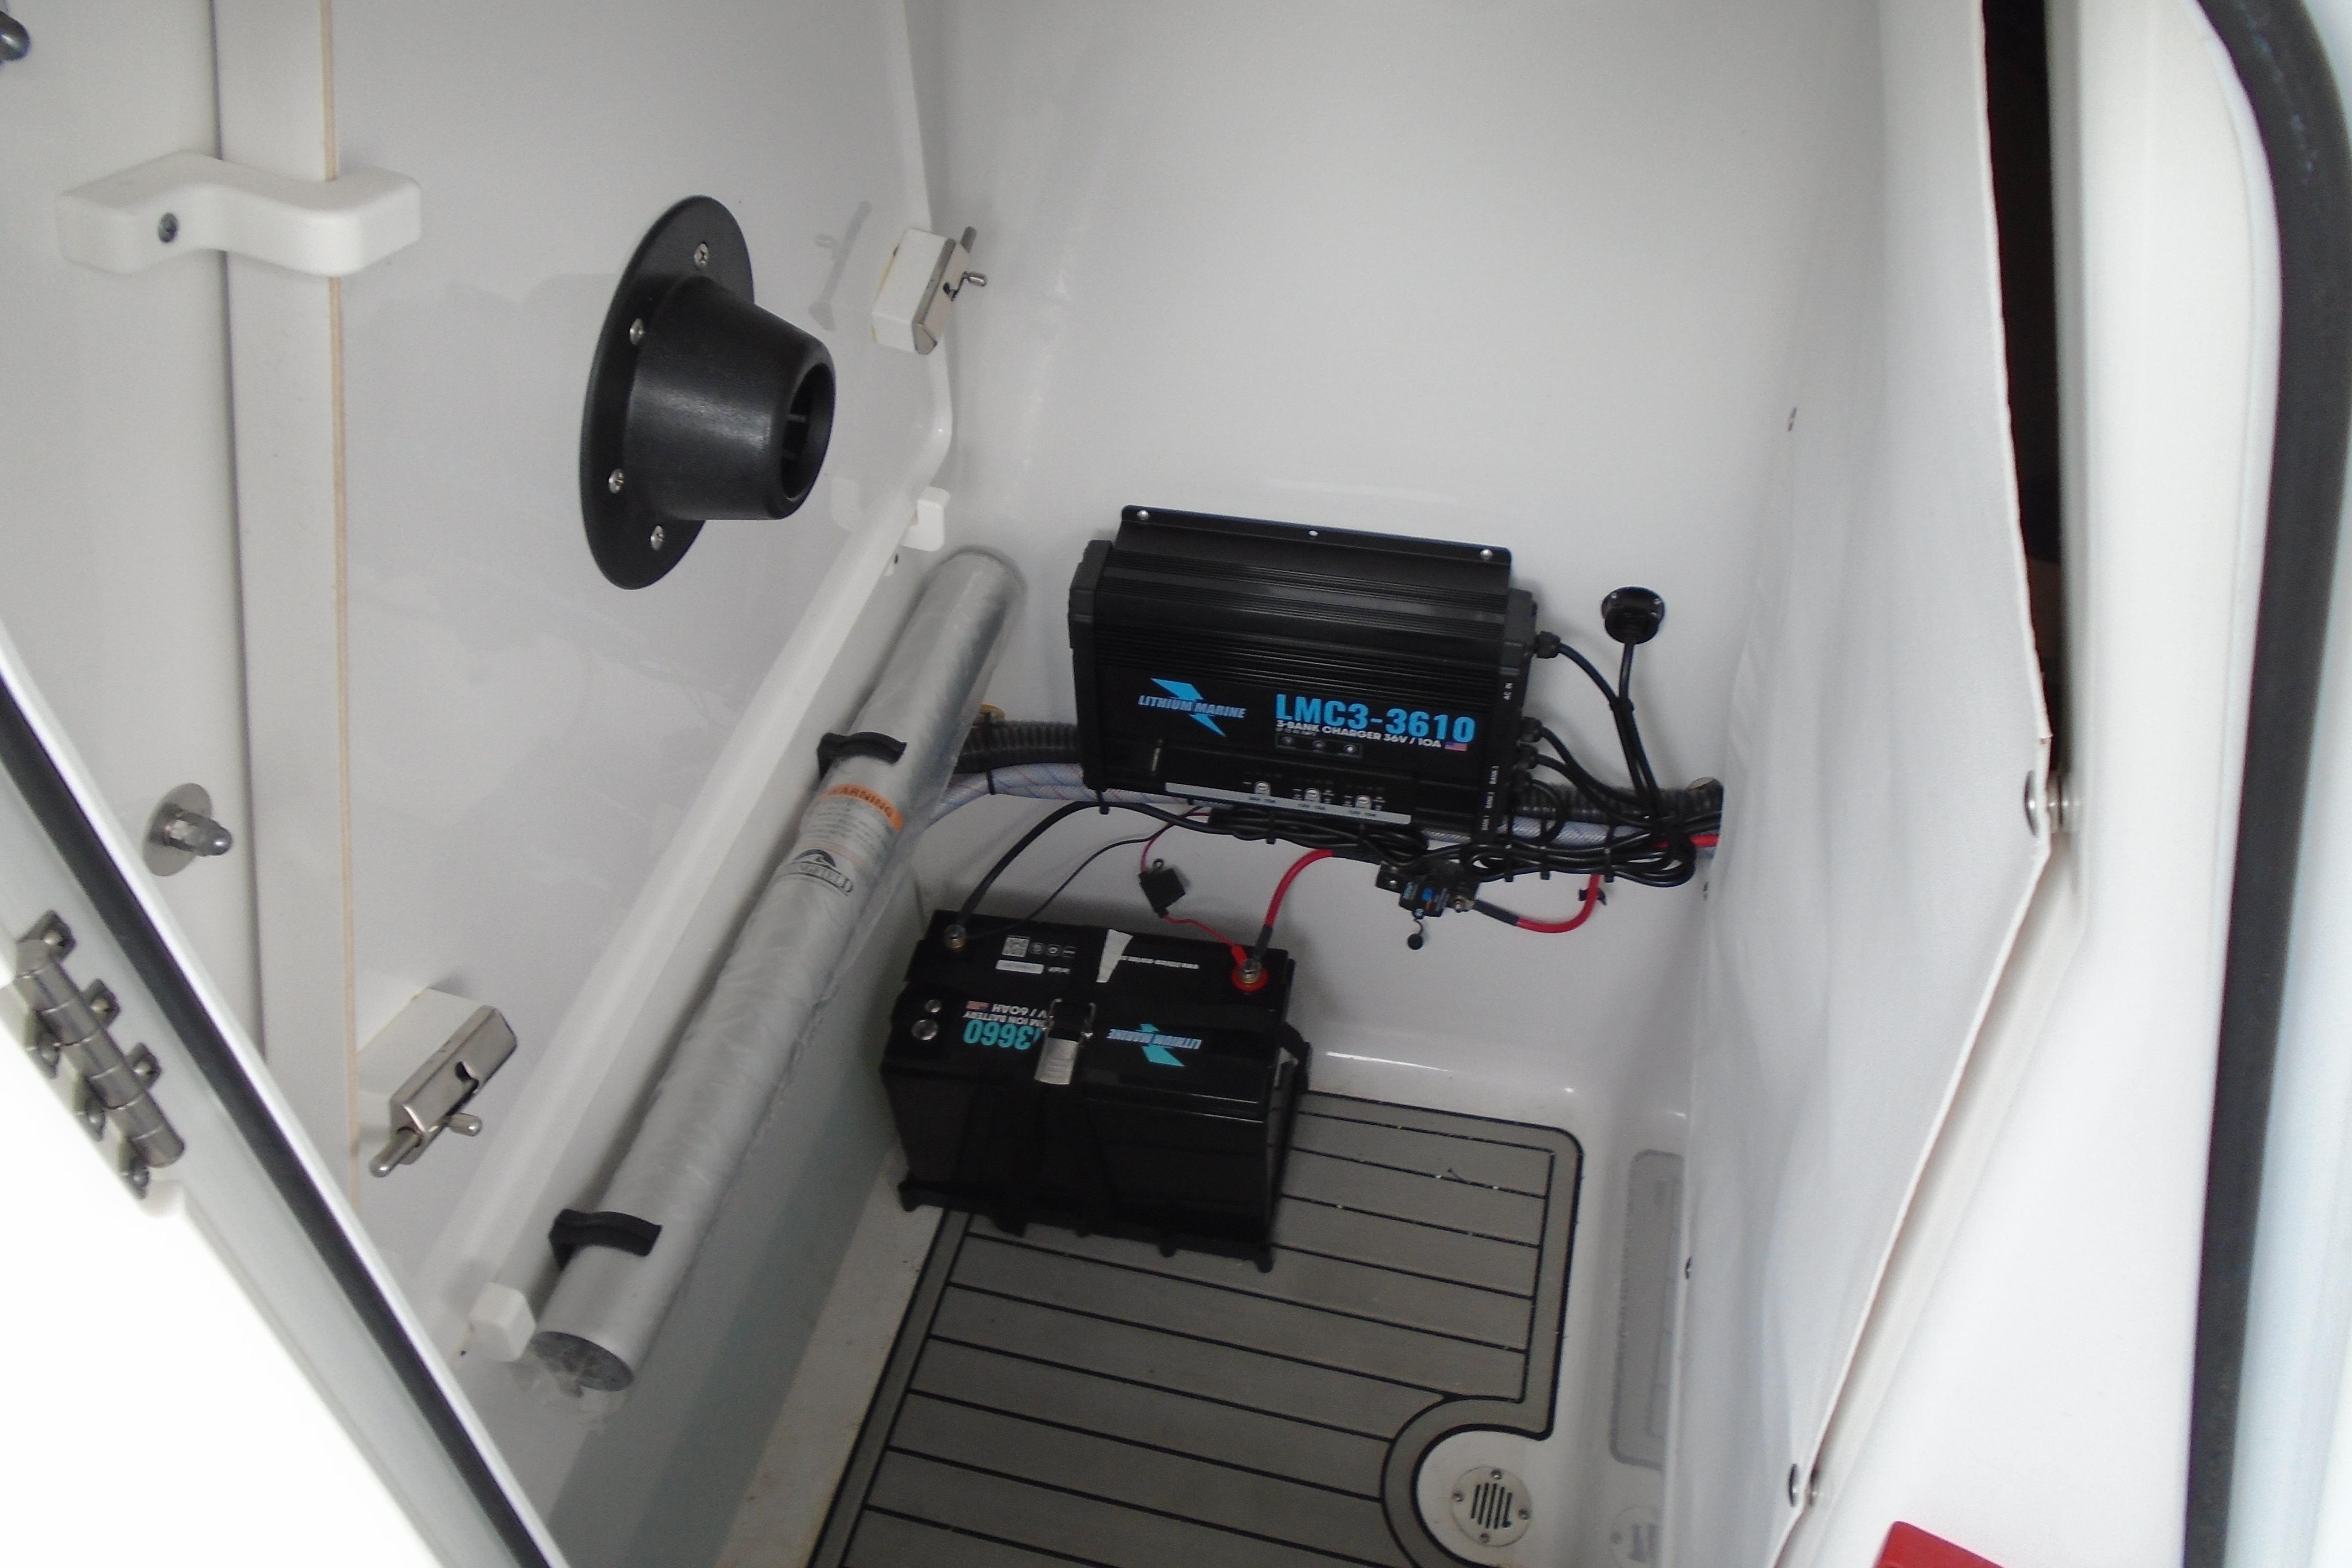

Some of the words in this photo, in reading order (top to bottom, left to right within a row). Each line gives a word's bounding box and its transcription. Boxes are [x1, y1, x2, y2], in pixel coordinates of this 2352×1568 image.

[1138, 695, 1193, 712] LITHIUM
[1194, 702, 1247, 719] MARINE
[1276, 694, 1475, 743] LMC3-3610
[1276, 720, 1320, 732] 3-BANK
[1321, 726, 1382, 740] CHARGER
[1383, 734, 1408, 743] 36V
[1418, 738, 1442, 748] 10A
[962, 1010, 1007, 1023] BATTERY
[991, 1003, 1029, 1015] 60AH
[1008, 1016, 1029, 1025] ION
[1107, 1028, 1155, 1044] MARINE
[1152, 1034, 1202, 1049] LITHIUM
